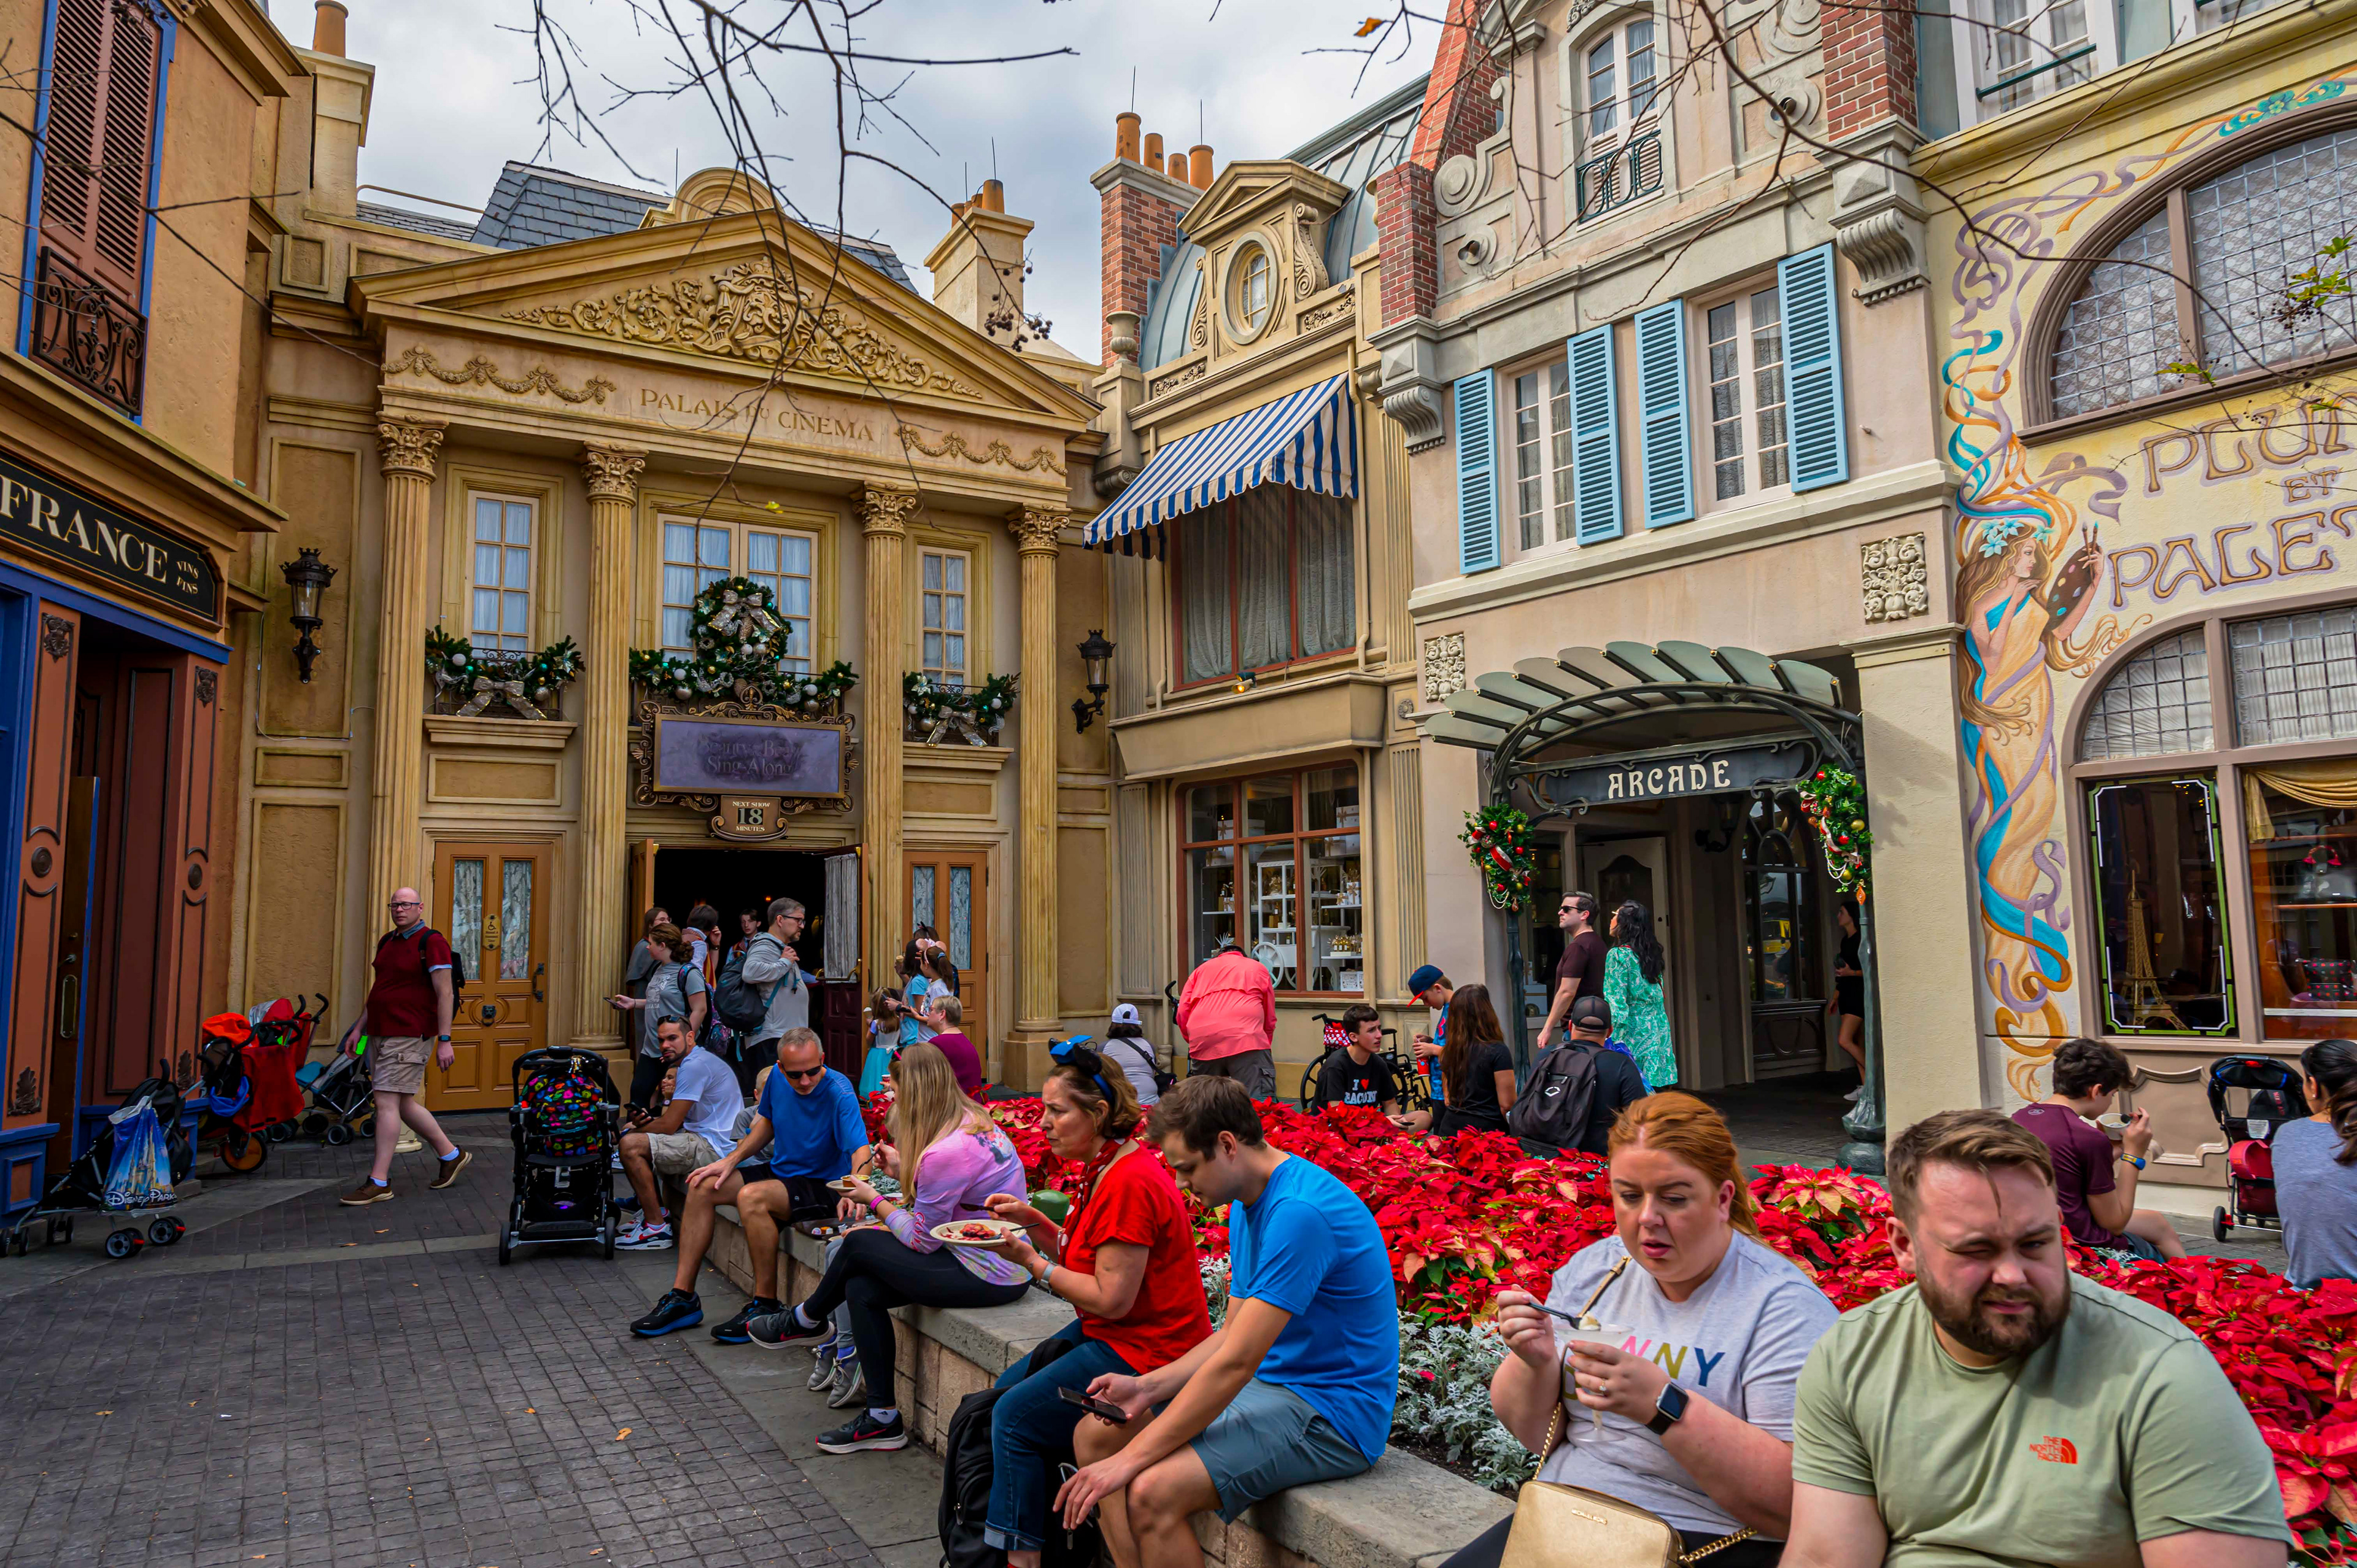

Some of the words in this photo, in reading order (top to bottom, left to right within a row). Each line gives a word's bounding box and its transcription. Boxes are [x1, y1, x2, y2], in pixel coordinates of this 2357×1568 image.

[640, 388, 738, 420] PALAIS
[745, 405, 770, 419] DU
[778, 411, 874, 441] CINEMA
[2284, 470, 2337, 503] ET
[0, 474, 168, 584] FRANCE
[176, 560, 199, 579] VINS
[176, 577, 199, 594] FINS
[1608, 760, 1731, 799] ARCADE
[738, 808, 762, 825] 18
[1352, 1079, 1360, 1091] I
[1344, 1091, 1377, 1105] BACON
[2029, 1443, 2062, 1454] NORTH
[2043, 1435, 2061, 1445] THE
[2037, 1451, 2061, 1463] FACE
